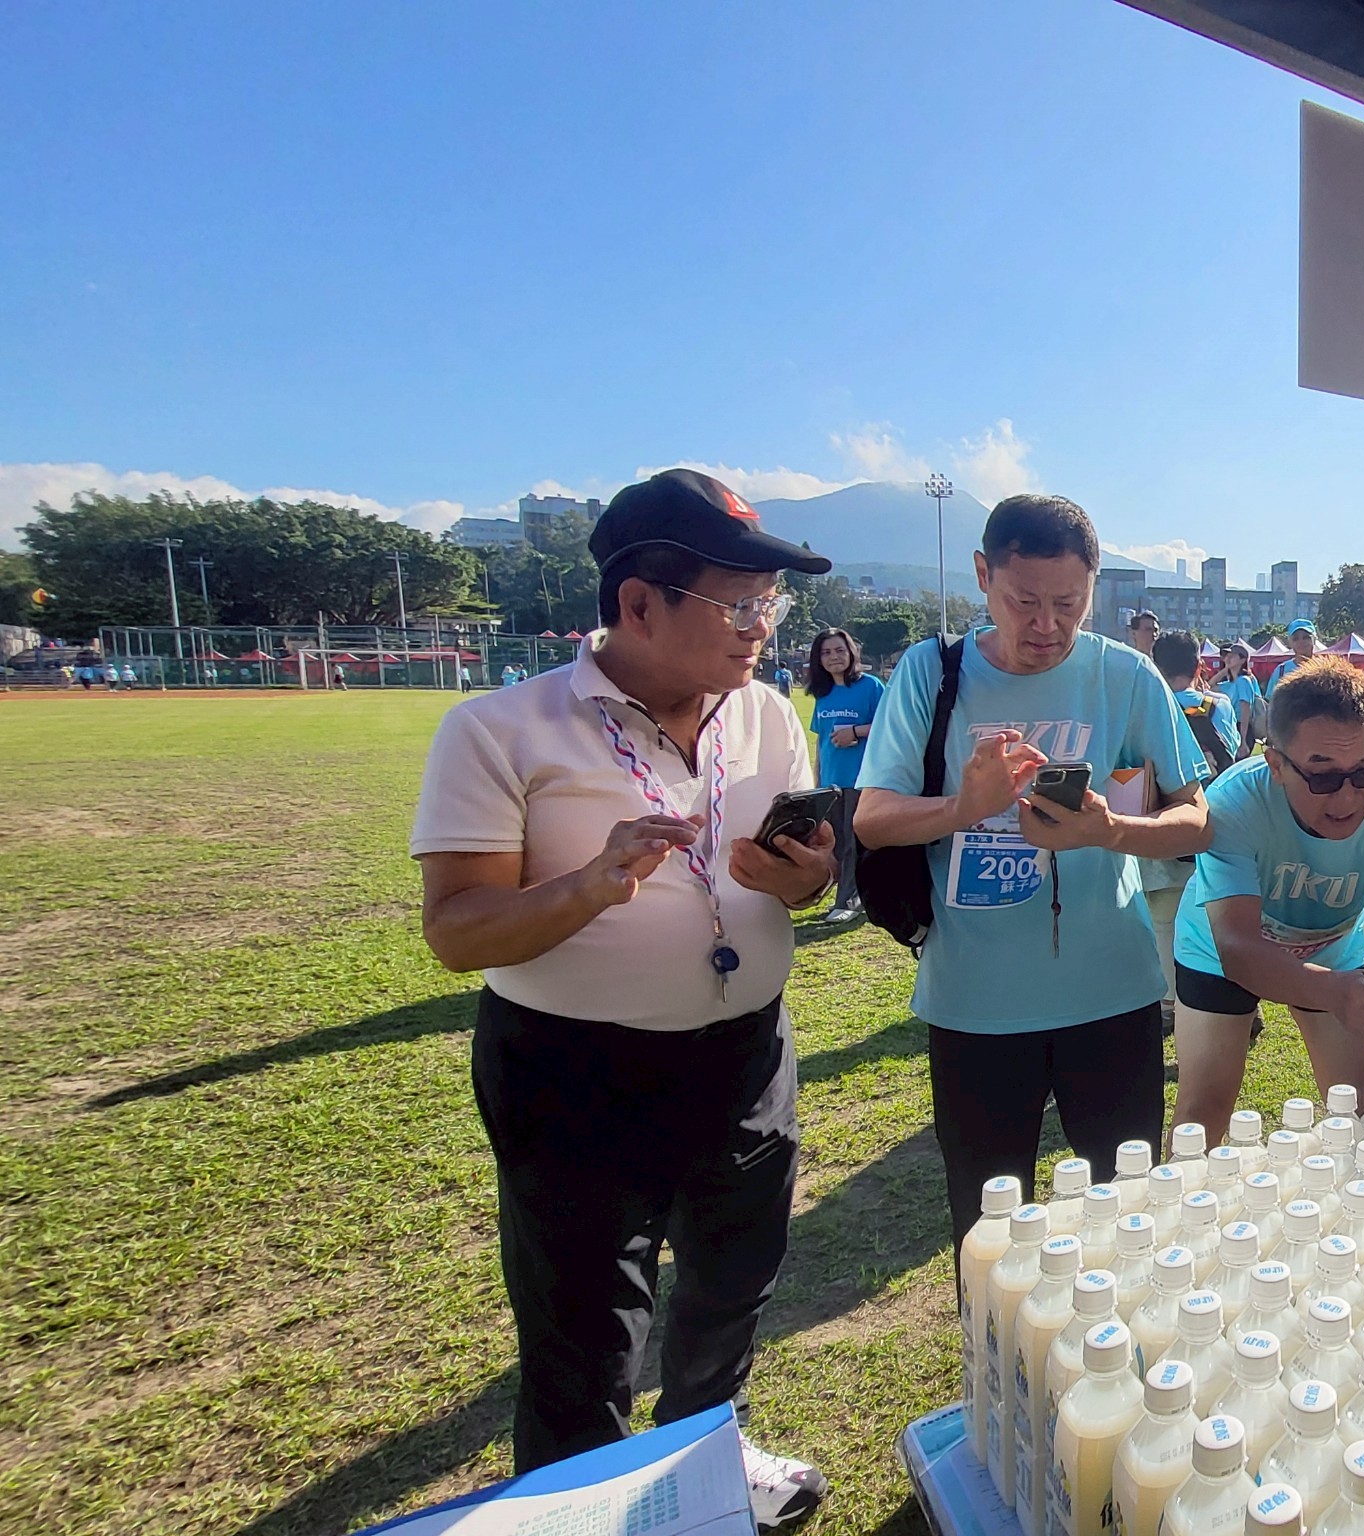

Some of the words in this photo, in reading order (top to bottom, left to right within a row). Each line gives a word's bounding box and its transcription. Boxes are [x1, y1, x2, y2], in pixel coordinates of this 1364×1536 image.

[821, 709, 859, 718] Columbia
[977, 857, 1042, 880] 200
[1268, 862, 1359, 908] TKU
